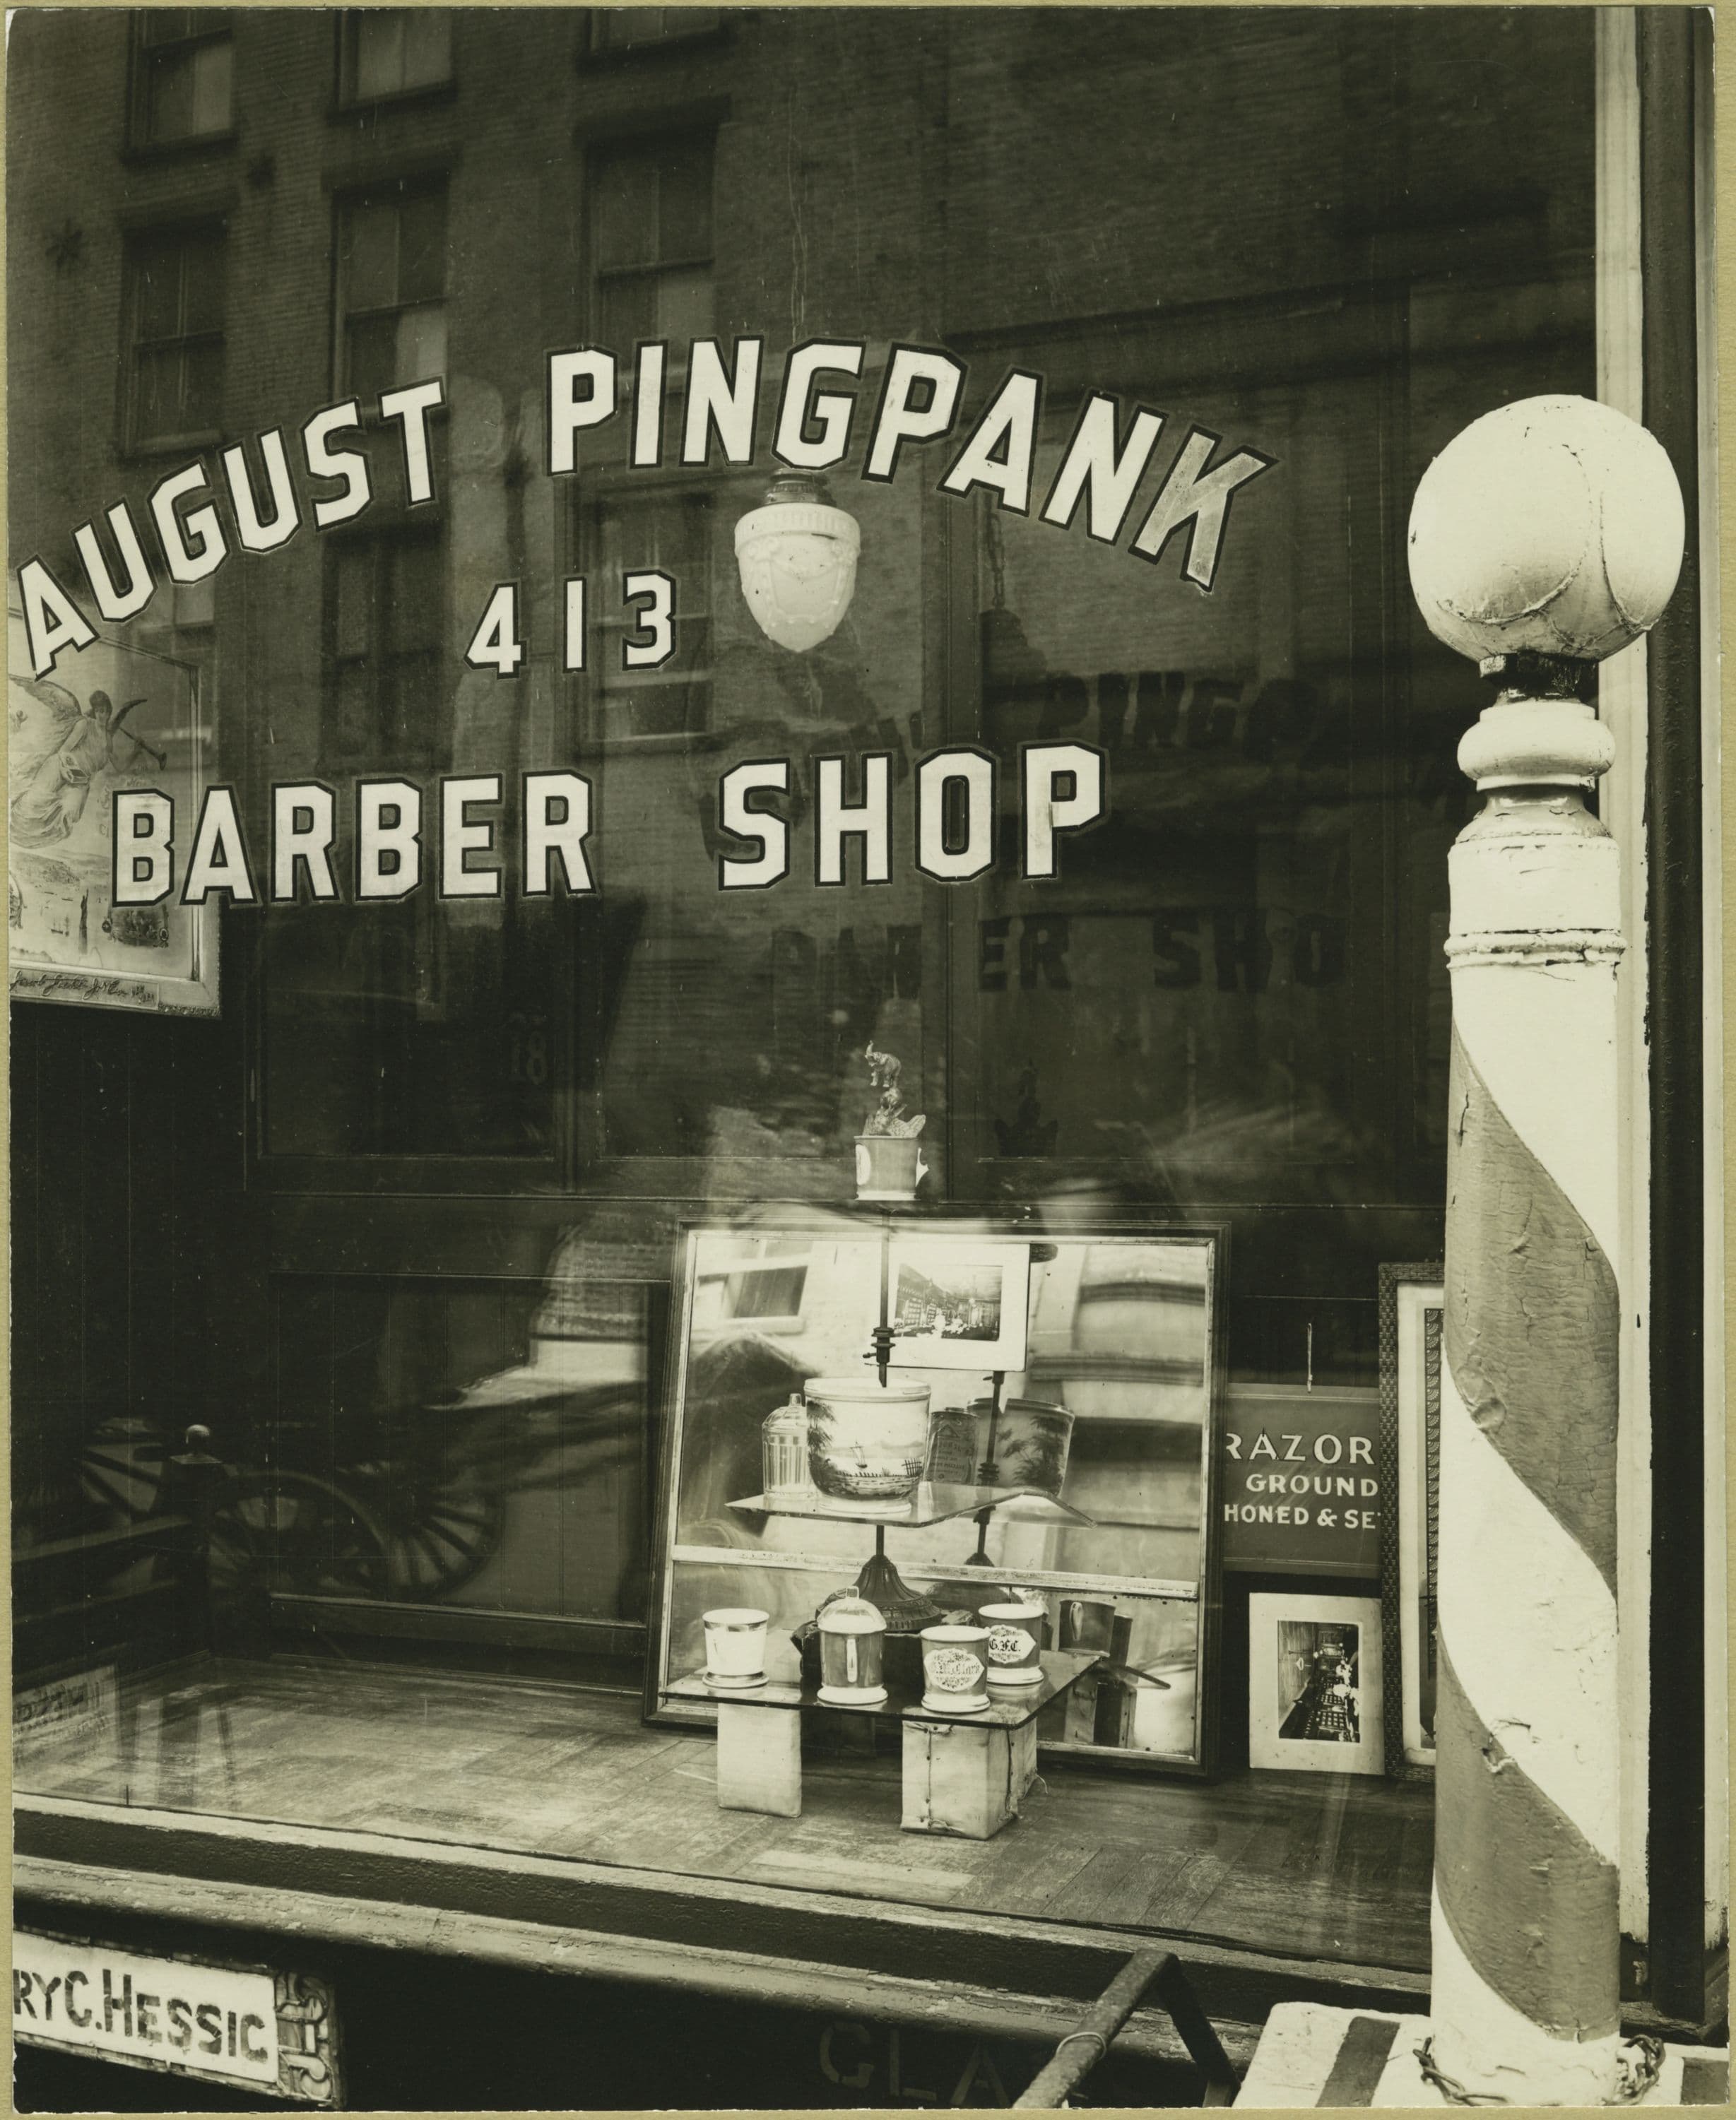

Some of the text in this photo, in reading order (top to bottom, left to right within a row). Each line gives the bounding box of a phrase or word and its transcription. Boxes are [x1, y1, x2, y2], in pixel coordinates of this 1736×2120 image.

[16, 336, 1277, 680] AUGUST PINGPANK
[463, 570, 676, 680] 413
[112, 769, 596, 908] BARBER
[719, 740, 1105, 890] SHOP
[1226, 1433, 1375, 1464] RAZOR
[1246, 1474, 1378, 1496] GROUND
[1224, 1504, 1381, 1529] HONED & SE
[820, 2022, 1015, 2108] GLA
